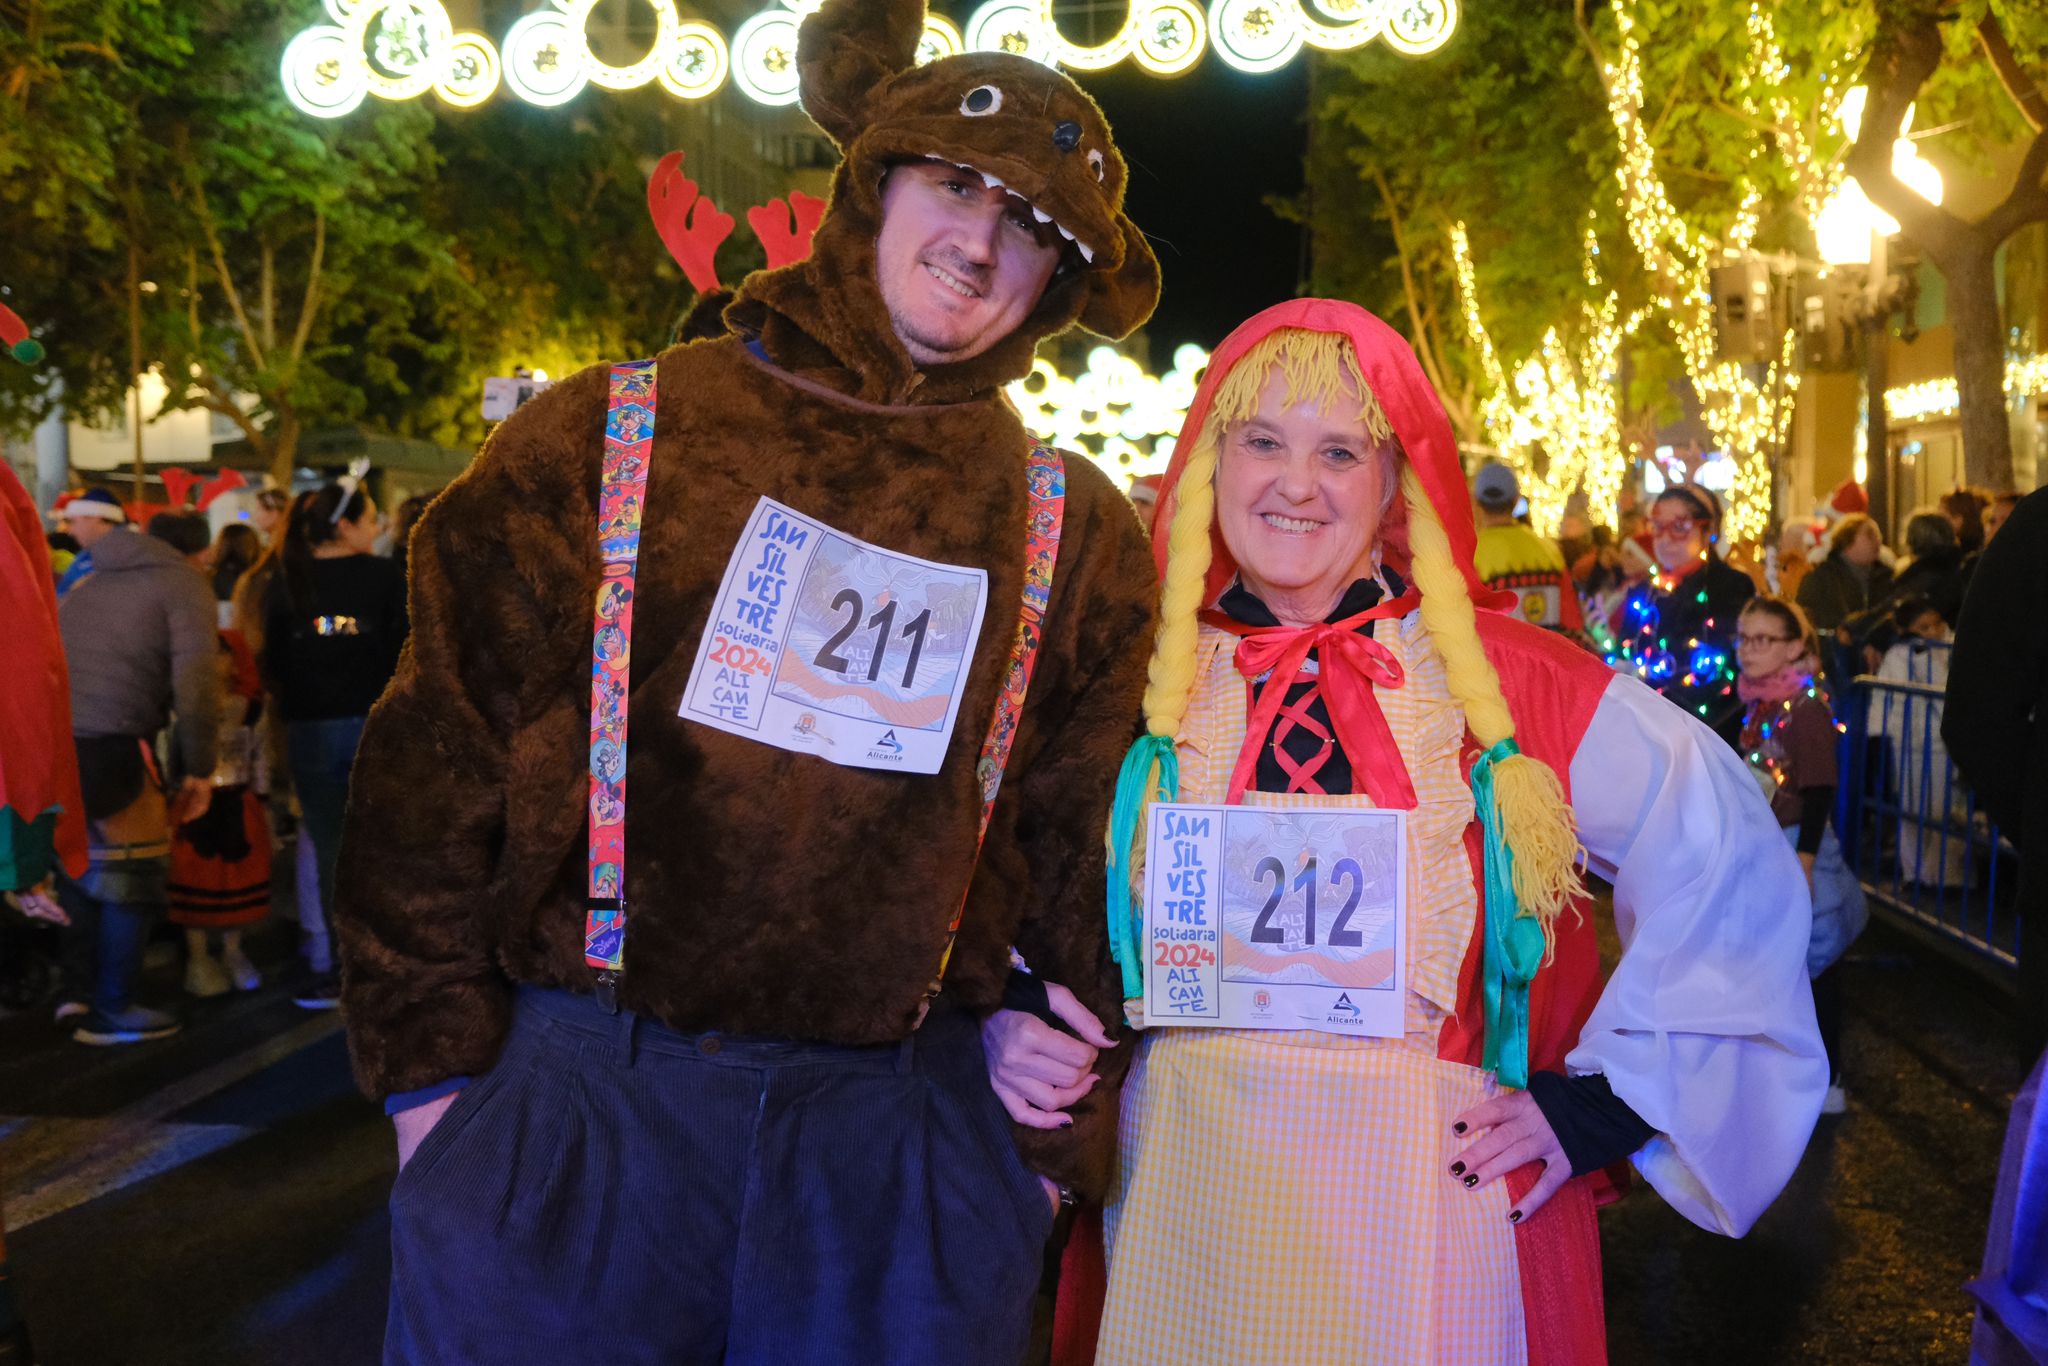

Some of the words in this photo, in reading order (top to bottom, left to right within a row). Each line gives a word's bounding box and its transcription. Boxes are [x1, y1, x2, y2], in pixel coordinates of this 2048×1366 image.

[759, 512, 809, 551] SAN
[747, 571, 788, 605] VES
[736, 598, 778, 634] TRE
[716, 620, 779, 653] solidaria
[812, 588, 932, 689] 211
[709, 636, 773, 677] 2024
[714, 667, 750, 689] ALI
[712, 686, 749, 705] CAN
[709, 703, 749, 720] TE
[867, 751, 903, 761] Alicante
[1163, 812, 1210, 841] SAN
[1166, 869, 1208, 898] VES
[1164, 900, 1207, 926] TRE
[1250, 856, 1364, 947] 212
[1153, 926, 1216, 941] solidaria
[1153, 942, 1216, 967] 2024
[1166, 968, 1201, 984] ALI
[1168, 985, 1204, 1001] CAN
[1169, 999, 1208, 1014] TE
[1327, 1016, 1364, 1025] Alicante
